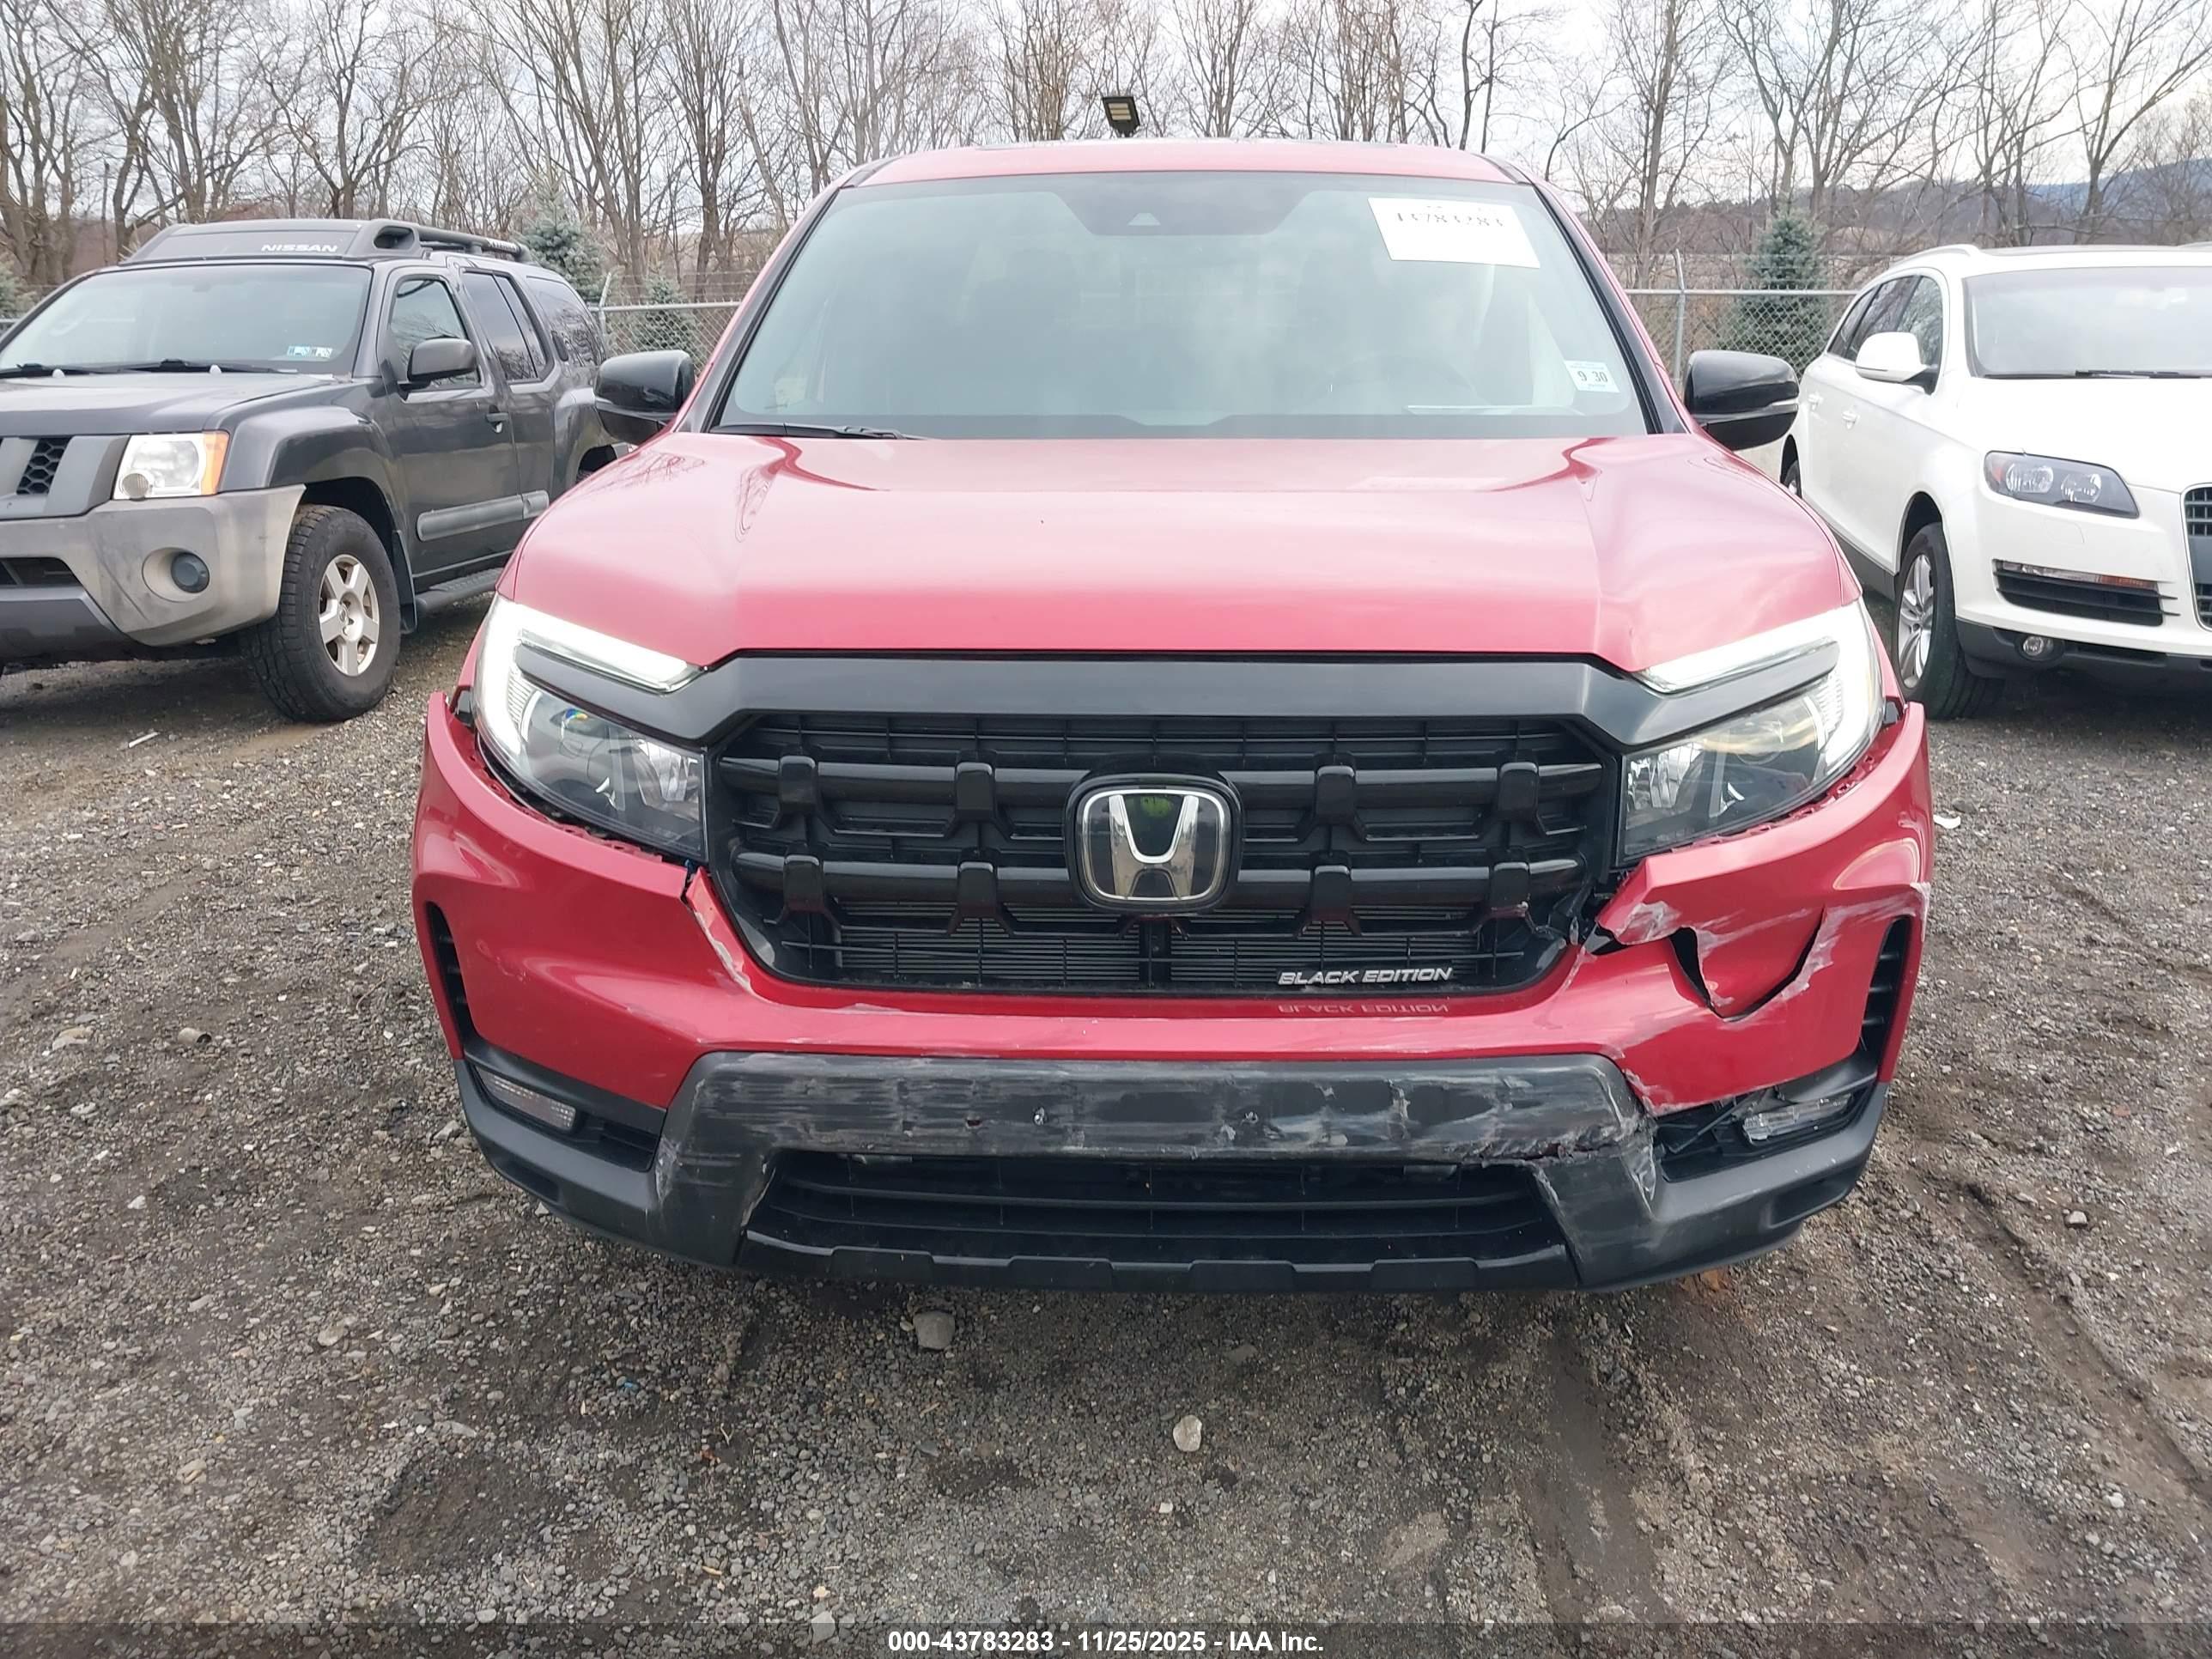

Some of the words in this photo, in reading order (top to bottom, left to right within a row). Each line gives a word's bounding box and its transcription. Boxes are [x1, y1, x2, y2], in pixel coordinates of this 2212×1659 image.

[261, 244, 337, 252] NISSAN
[1577, 370, 1588, 382] 9
[1592, 371, 1608, 383] 30
[1278, 970, 1359, 986] BLACK
[1362, 967, 1453, 984] EDITION
